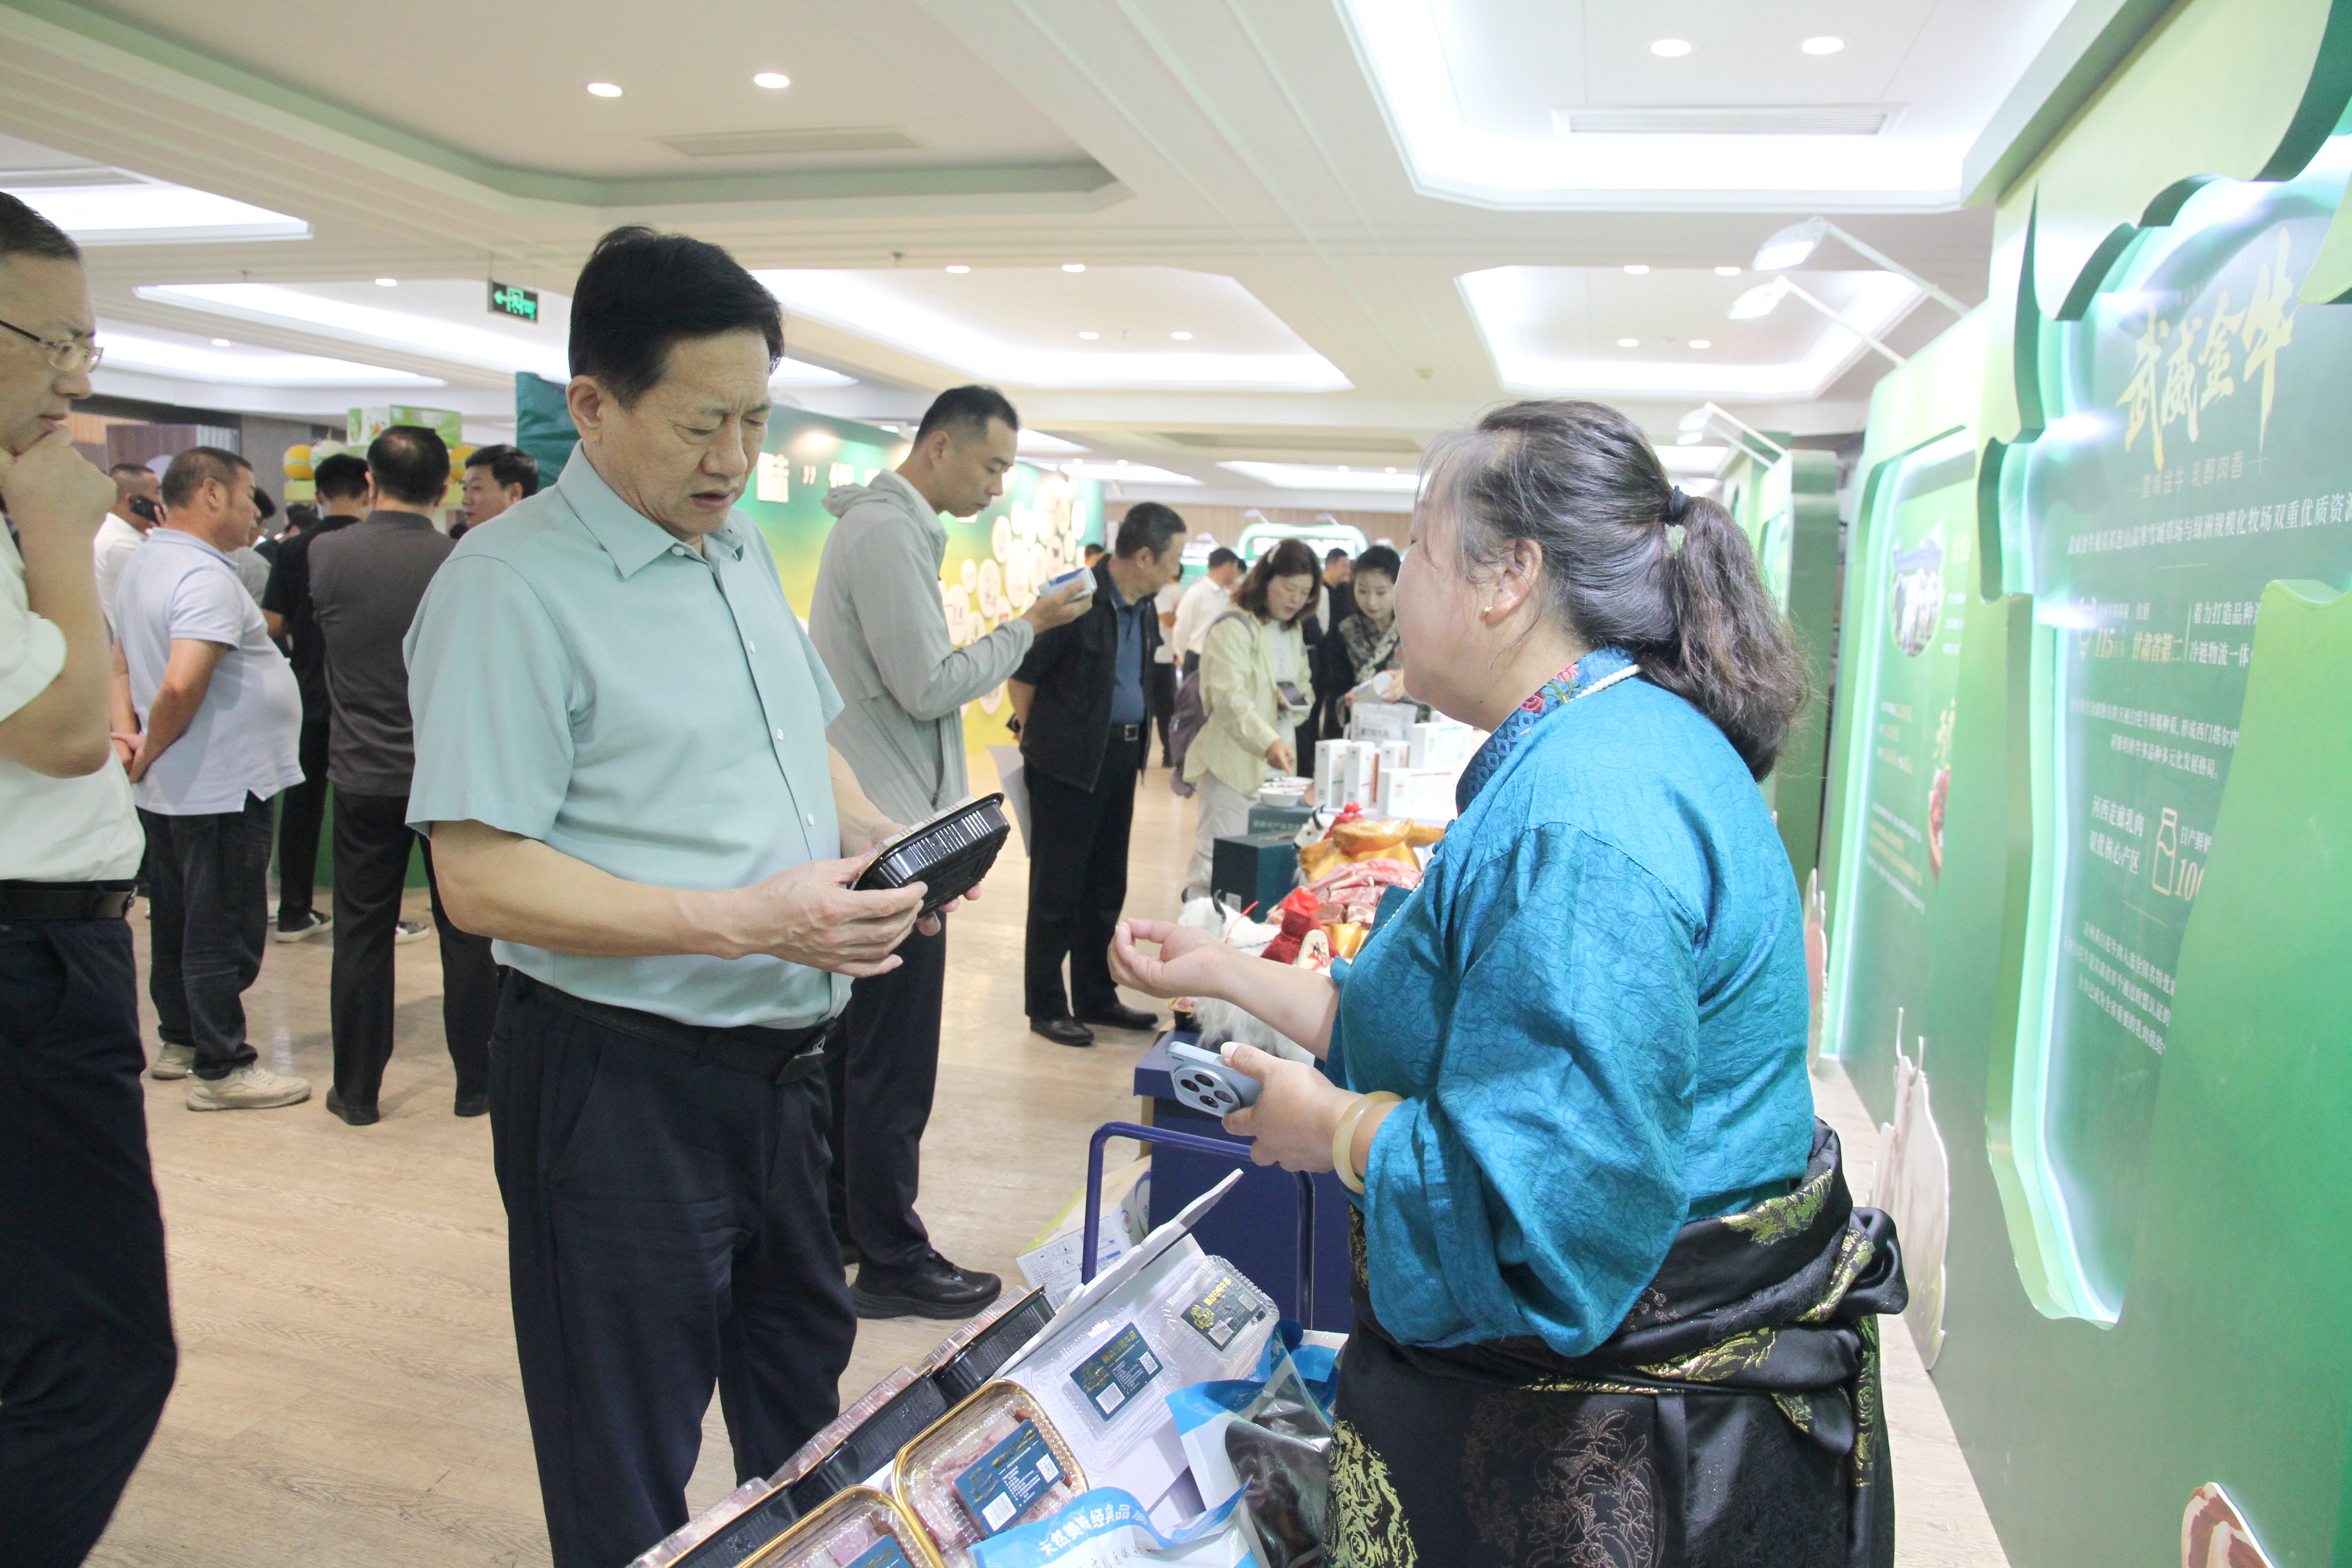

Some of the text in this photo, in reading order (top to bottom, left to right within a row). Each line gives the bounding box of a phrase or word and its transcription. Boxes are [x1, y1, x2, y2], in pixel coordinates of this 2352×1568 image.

[2190, 640, 2254, 667] 冷链物流一体
